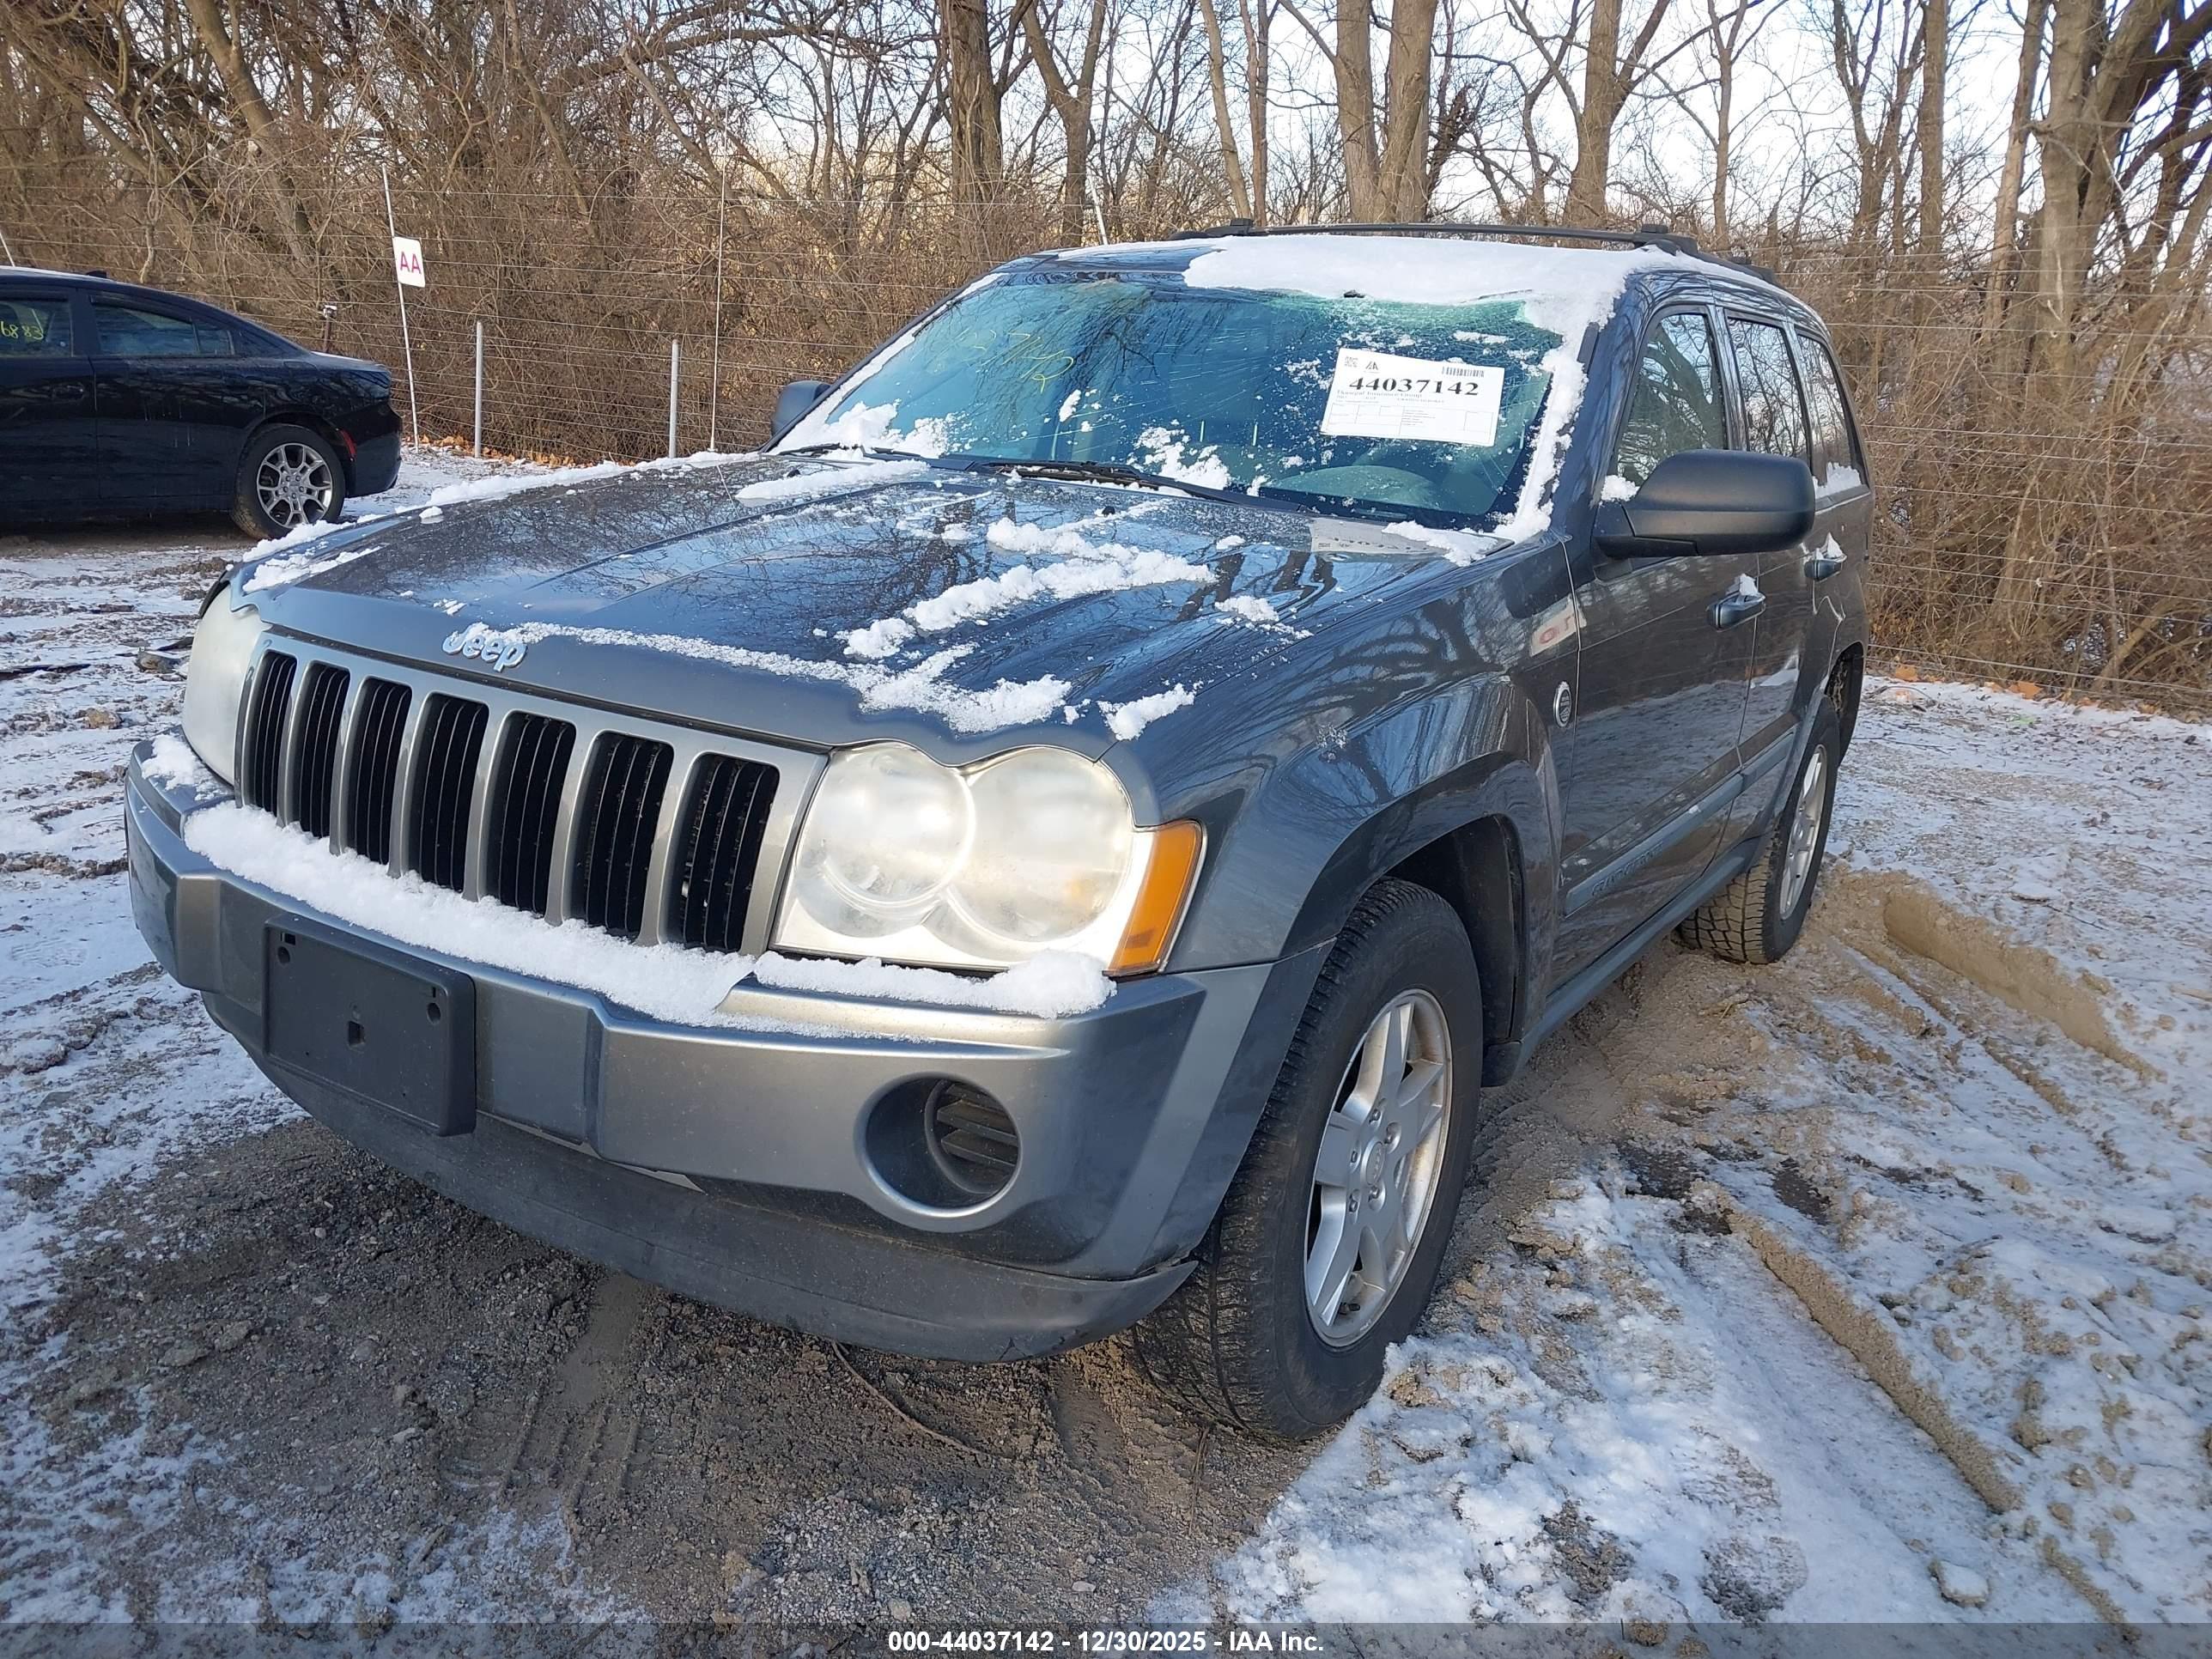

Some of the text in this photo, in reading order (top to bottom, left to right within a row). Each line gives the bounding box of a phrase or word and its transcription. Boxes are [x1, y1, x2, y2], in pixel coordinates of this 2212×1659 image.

[399, 251, 422, 275] AA
[1349, 377, 1479, 396] 44037142
[442, 622, 527, 672] Jeep
